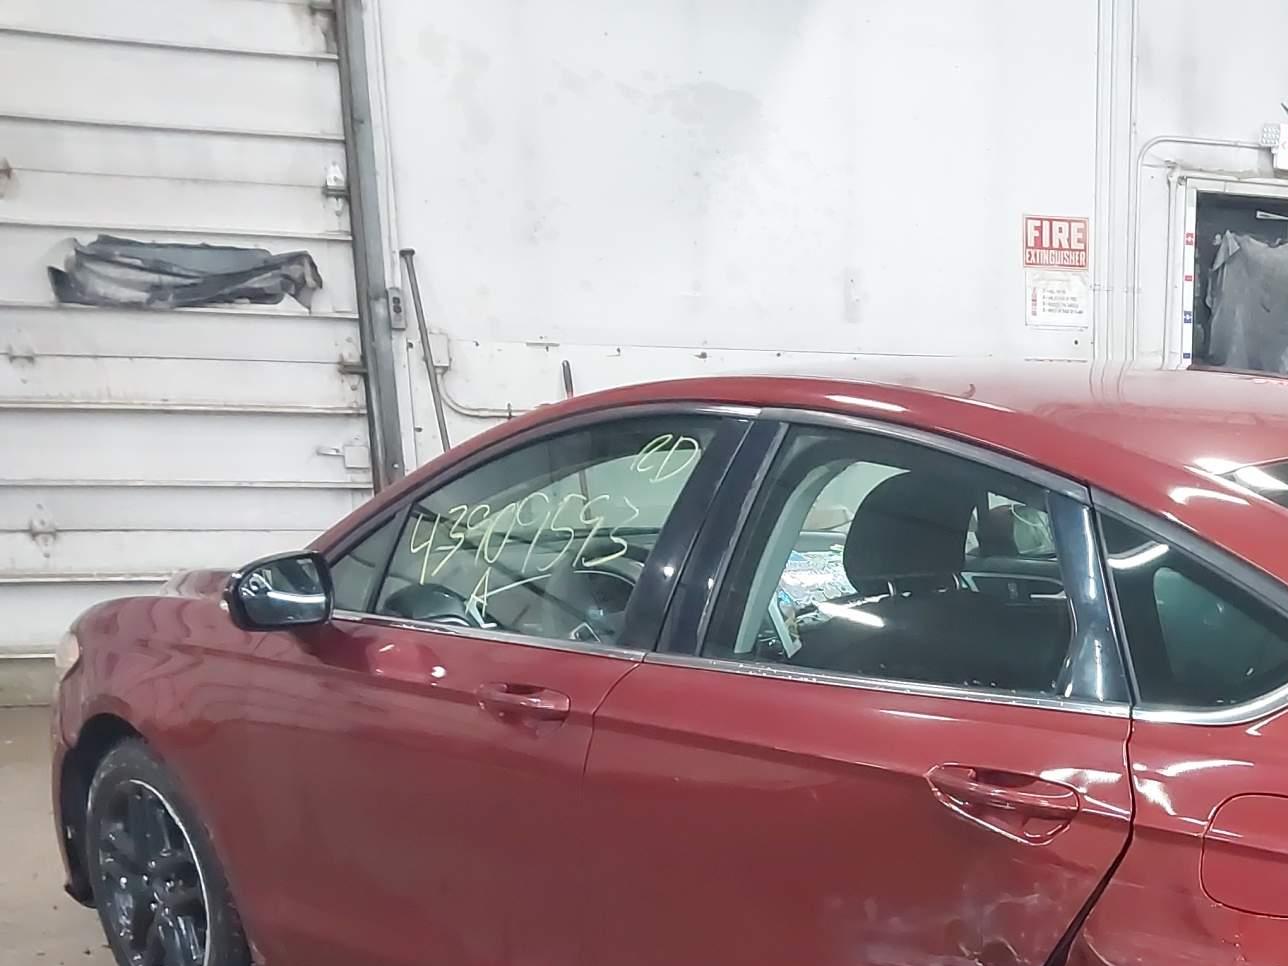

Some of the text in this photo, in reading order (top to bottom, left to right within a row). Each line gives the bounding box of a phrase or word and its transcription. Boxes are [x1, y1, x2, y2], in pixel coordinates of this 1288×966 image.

[1026, 219, 1085, 250] FIRE
[1026, 249, 1086, 267] EXTINGUISHER
[410, 492, 640, 586] 43909593
